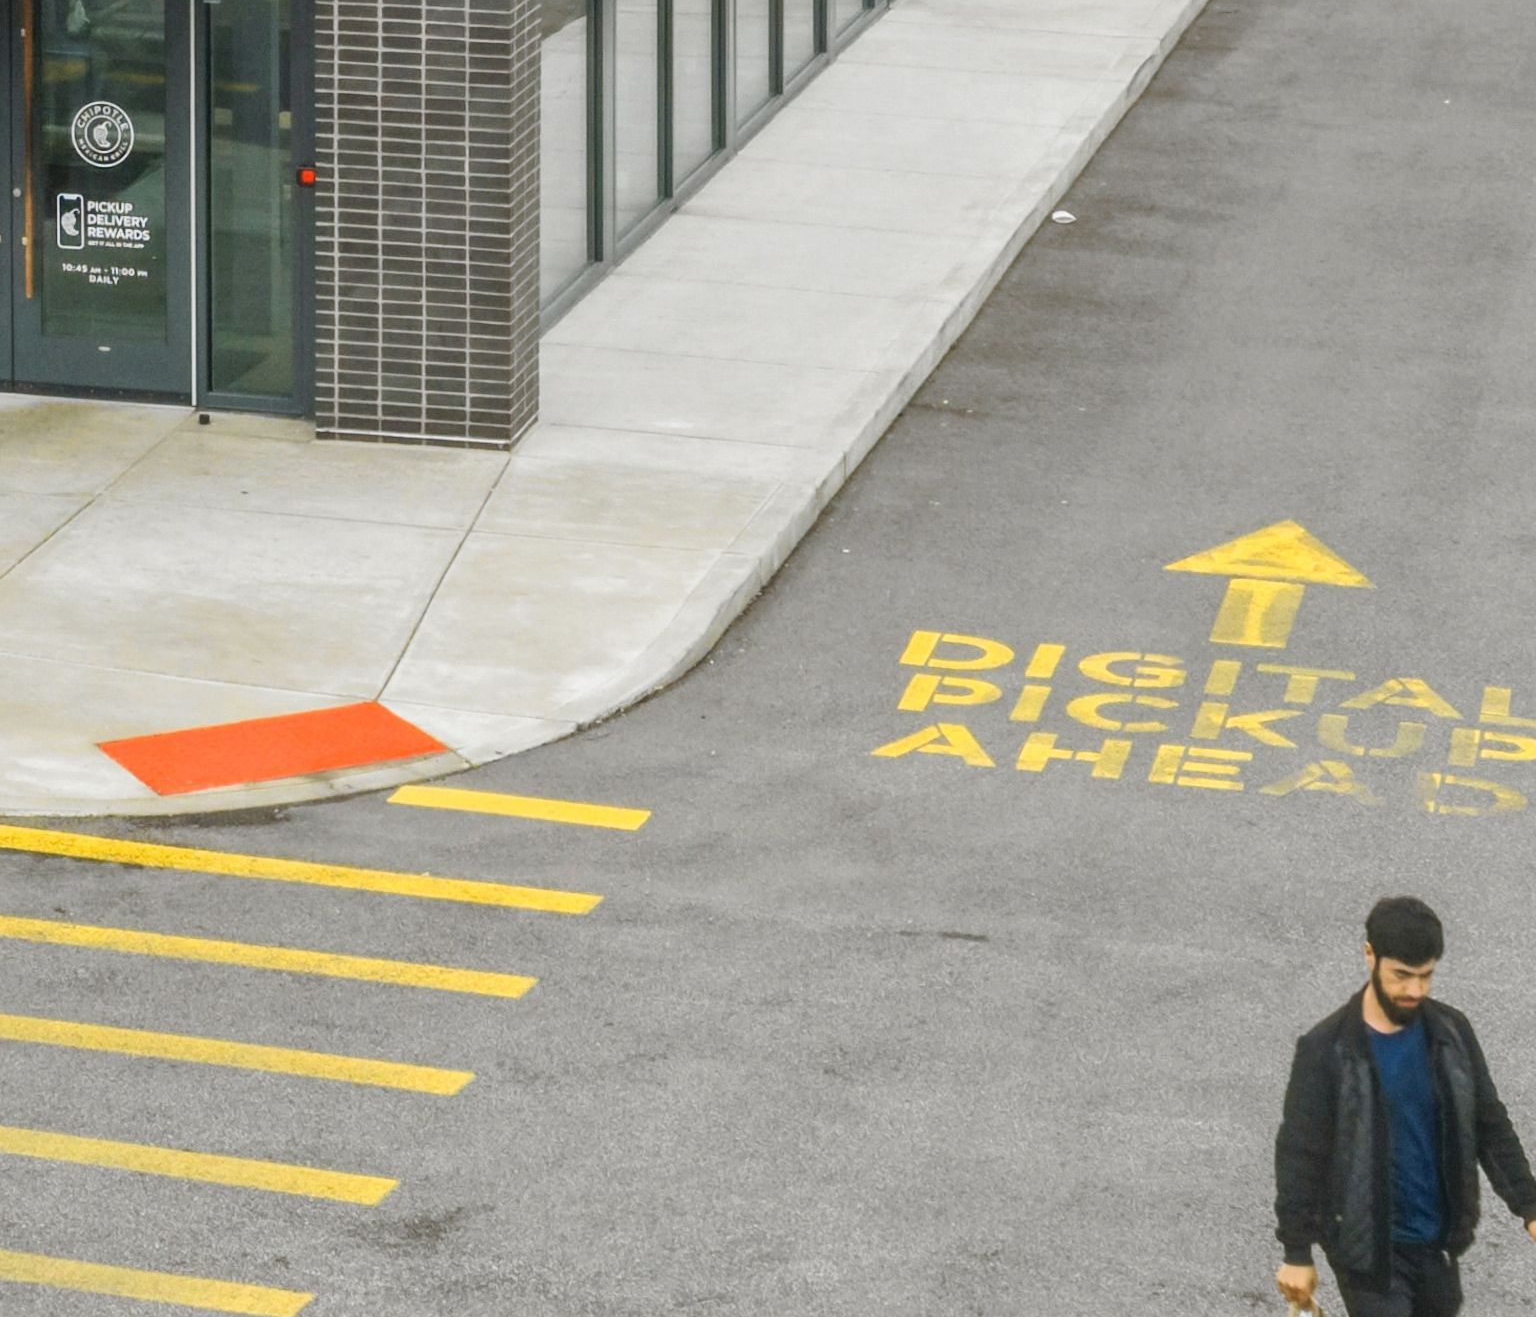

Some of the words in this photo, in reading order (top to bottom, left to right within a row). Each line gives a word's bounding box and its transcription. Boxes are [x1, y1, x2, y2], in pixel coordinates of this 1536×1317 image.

[77, 105, 129, 132] CHIPOTLE
[87, 201, 133, 213] PICKUP
[87, 214, 148, 227] DELIVERY
[87, 227, 150, 241] REWARDS
[62, 263, 88, 273] 10:45
[110, 267, 135, 276] 11:00
[89, 274, 119, 284] DAILY
[870, 722, 1529, 816] AHEAD
